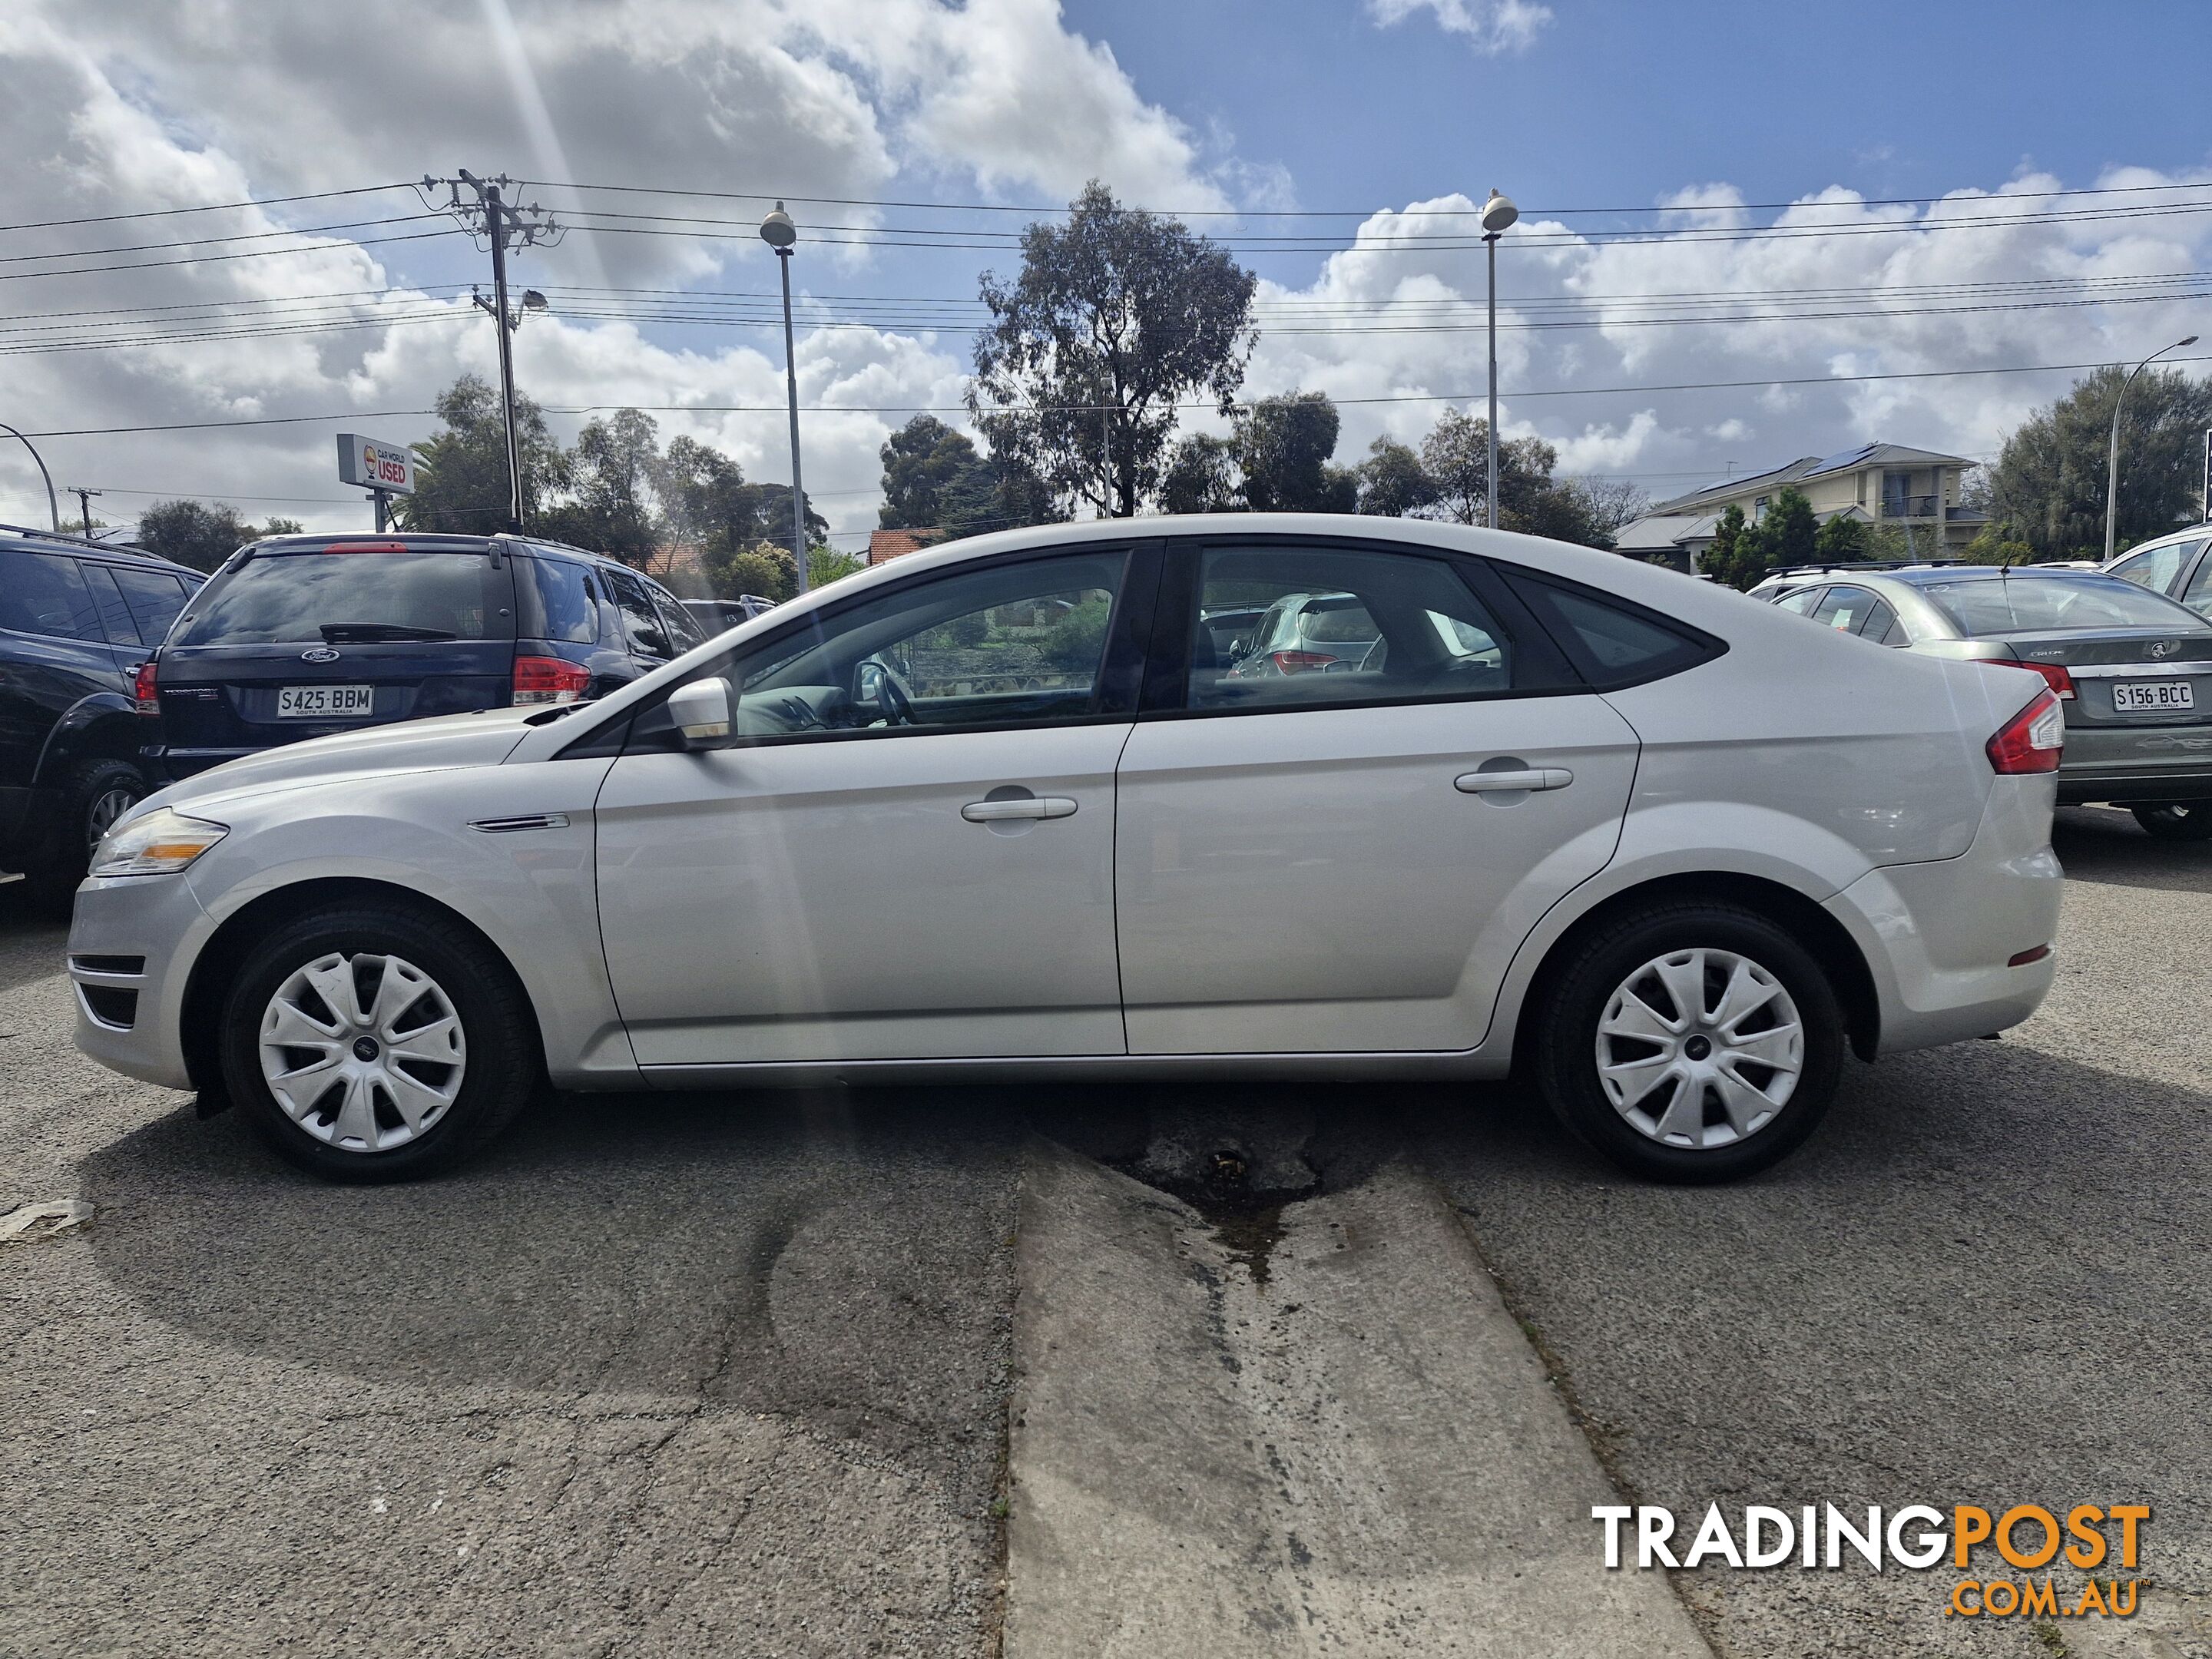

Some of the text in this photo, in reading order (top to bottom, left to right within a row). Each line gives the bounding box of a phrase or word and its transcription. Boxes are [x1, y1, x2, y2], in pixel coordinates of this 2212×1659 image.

[377, 449, 405, 463] CAR WORLD
[378, 459, 406, 484] USED
[281, 690, 369, 710] S425-BBM
[2117, 687, 2190, 705] S156-BCC
